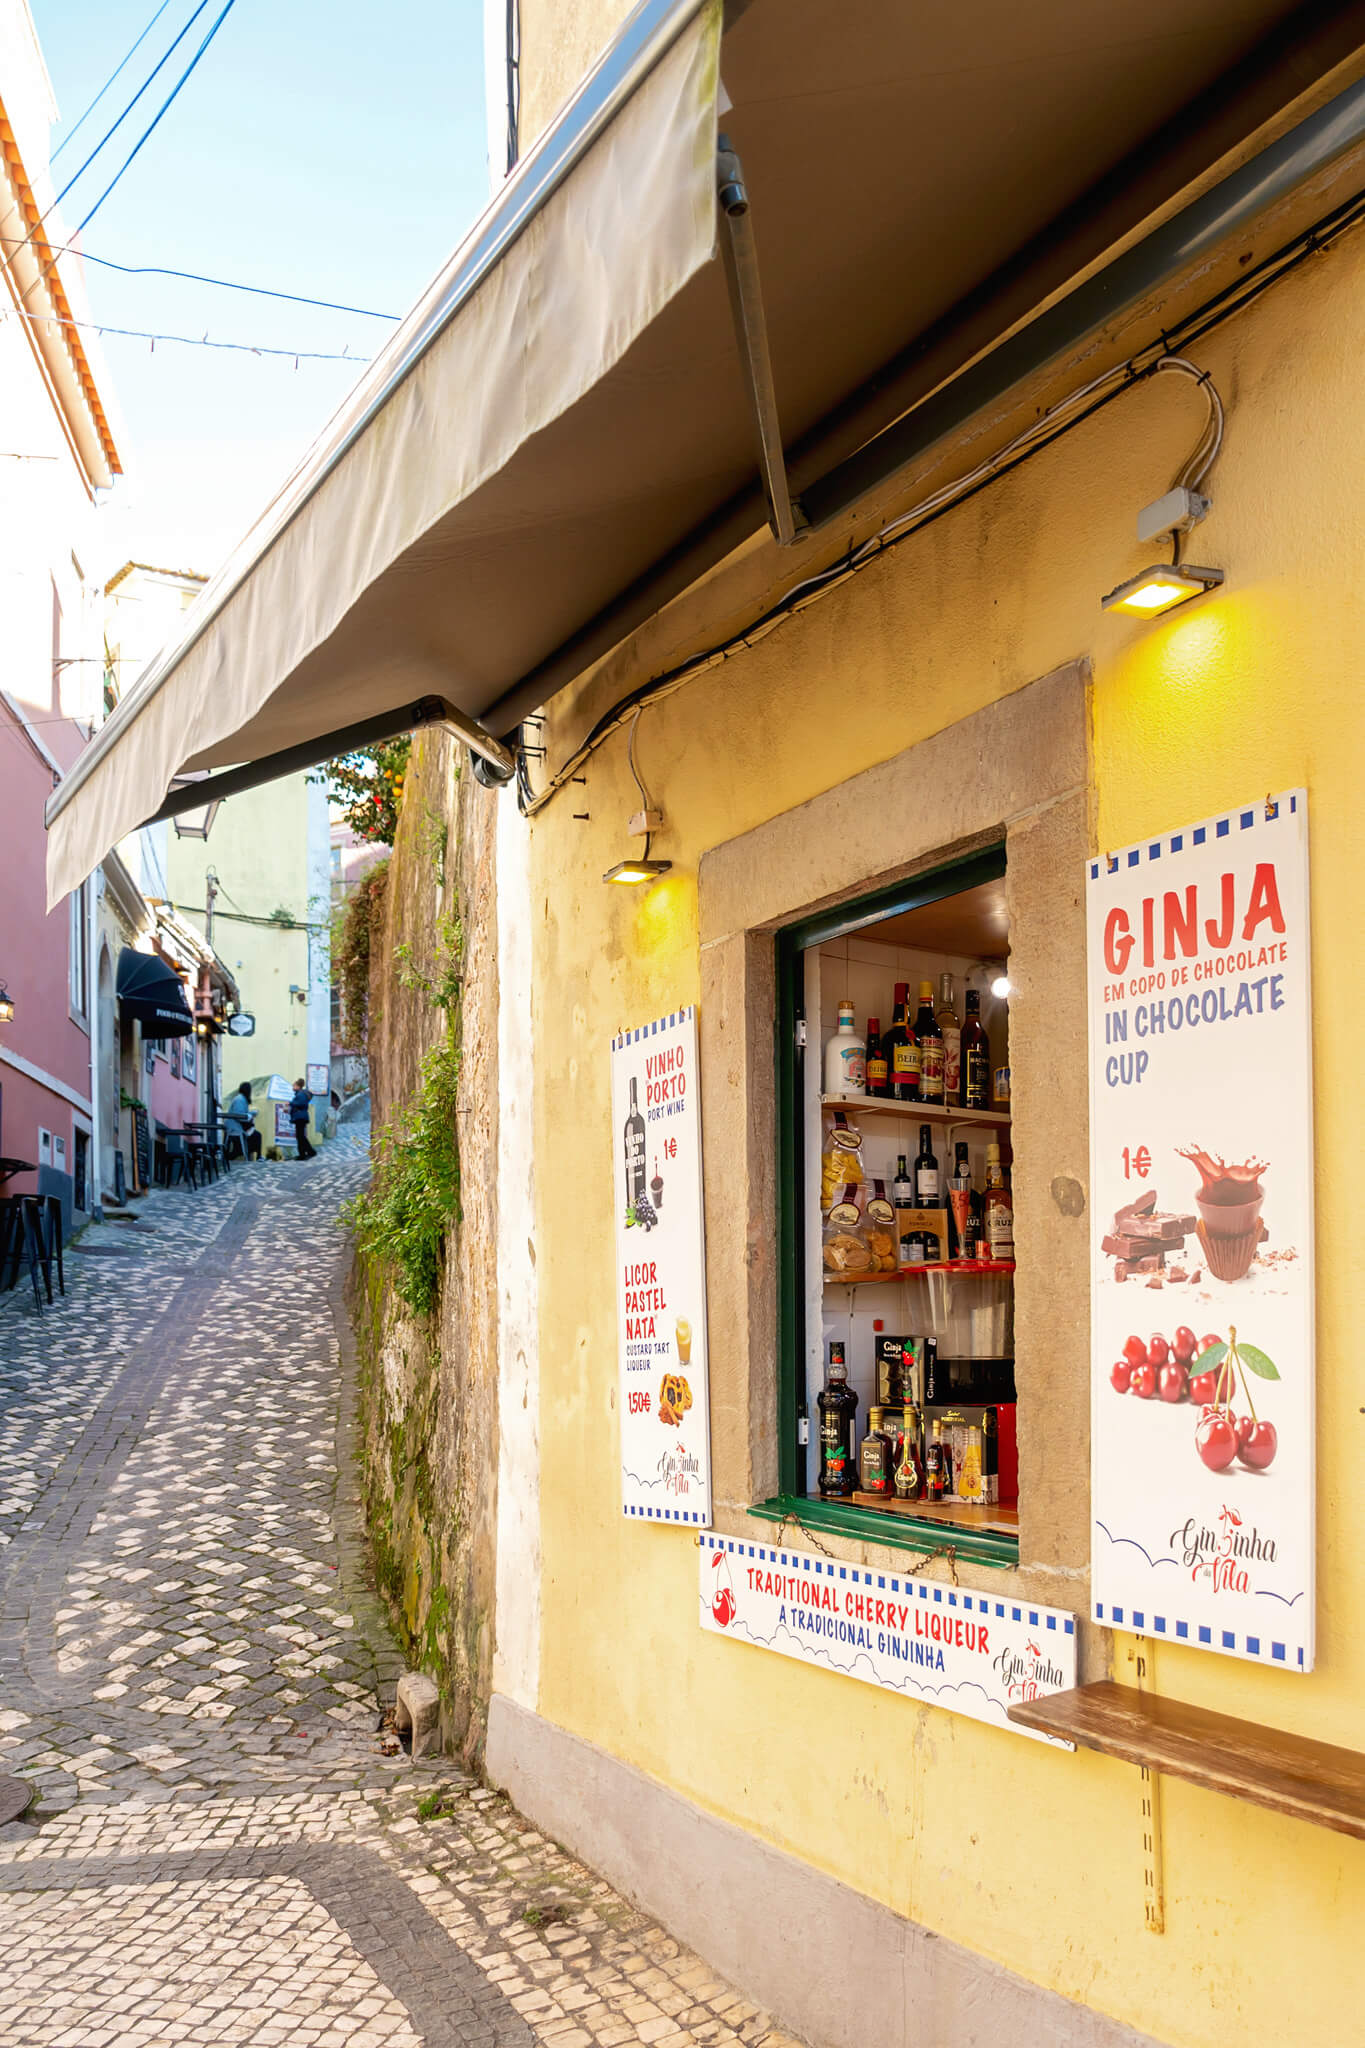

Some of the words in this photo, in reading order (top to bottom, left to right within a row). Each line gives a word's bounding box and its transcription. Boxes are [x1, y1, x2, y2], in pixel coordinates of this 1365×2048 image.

[1103, 862, 1287, 976] GINJA
[1104, 982, 1125, 1003] EM
[1129, 971, 1166, 998] COPO
[1172, 965, 1189, 987] DE
[1194, 941, 1288, 982] CHOCOLATE
[1105, 1009, 1128, 1045] IN
[1134, 973, 1285, 1037] CHOCOLATE
[645, 1045, 684, 1079] VINHO
[896, 1053, 918, 1065] BEIR
[1105, 1050, 1149, 1088] CUP
[646, 1073, 686, 1107] PORTO
[647, 1105, 665, 1122] PORT
[666, 1099, 685, 1116] WINE
[664, 1137, 677, 1160] 1€
[1121, 1145, 1152, 1180] 1€
[624, 1262, 657, 1287] LICOR
[625, 1288, 667, 1313] PASTEL
[626, 1316, 656, 1340] NATA
[626, 1344, 652, 1356] CUSTARD
[654, 1342, 670, 1354] TART
[626, 1359, 651, 1371] LIQUEUR
[1192, 1556, 1249, 1594] Vila
[746, 1567, 840, 1612] TRADITIONAL
[845, 1591, 909, 1631] CHERRY
[915, 1609, 990, 1656] LIQUEUR
[779, 1605, 787, 1624] A
[790, 1607, 873, 1649] TRADICIONAL
[877, 1632, 946, 1673] GINJINHA
